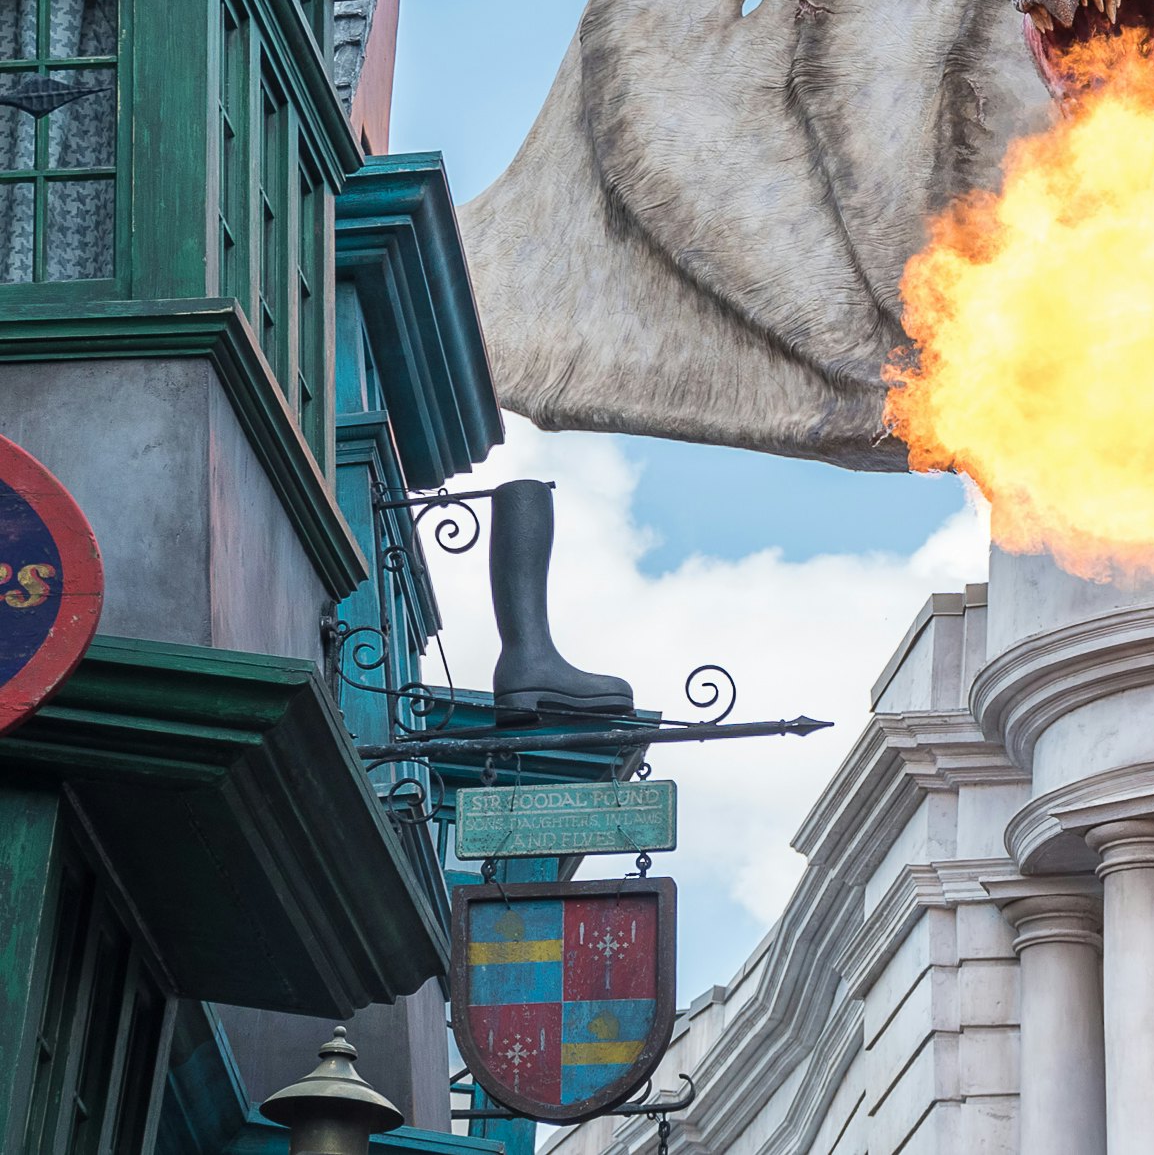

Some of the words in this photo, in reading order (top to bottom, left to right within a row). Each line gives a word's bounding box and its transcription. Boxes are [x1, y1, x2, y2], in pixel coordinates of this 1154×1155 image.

[471, 794, 503, 811] SIR
[506, 790, 588, 810] GOODAL
[591, 788, 660, 806] POUND
[510, 832, 557, 849] AND
[561, 830, 616, 847] ELVES
